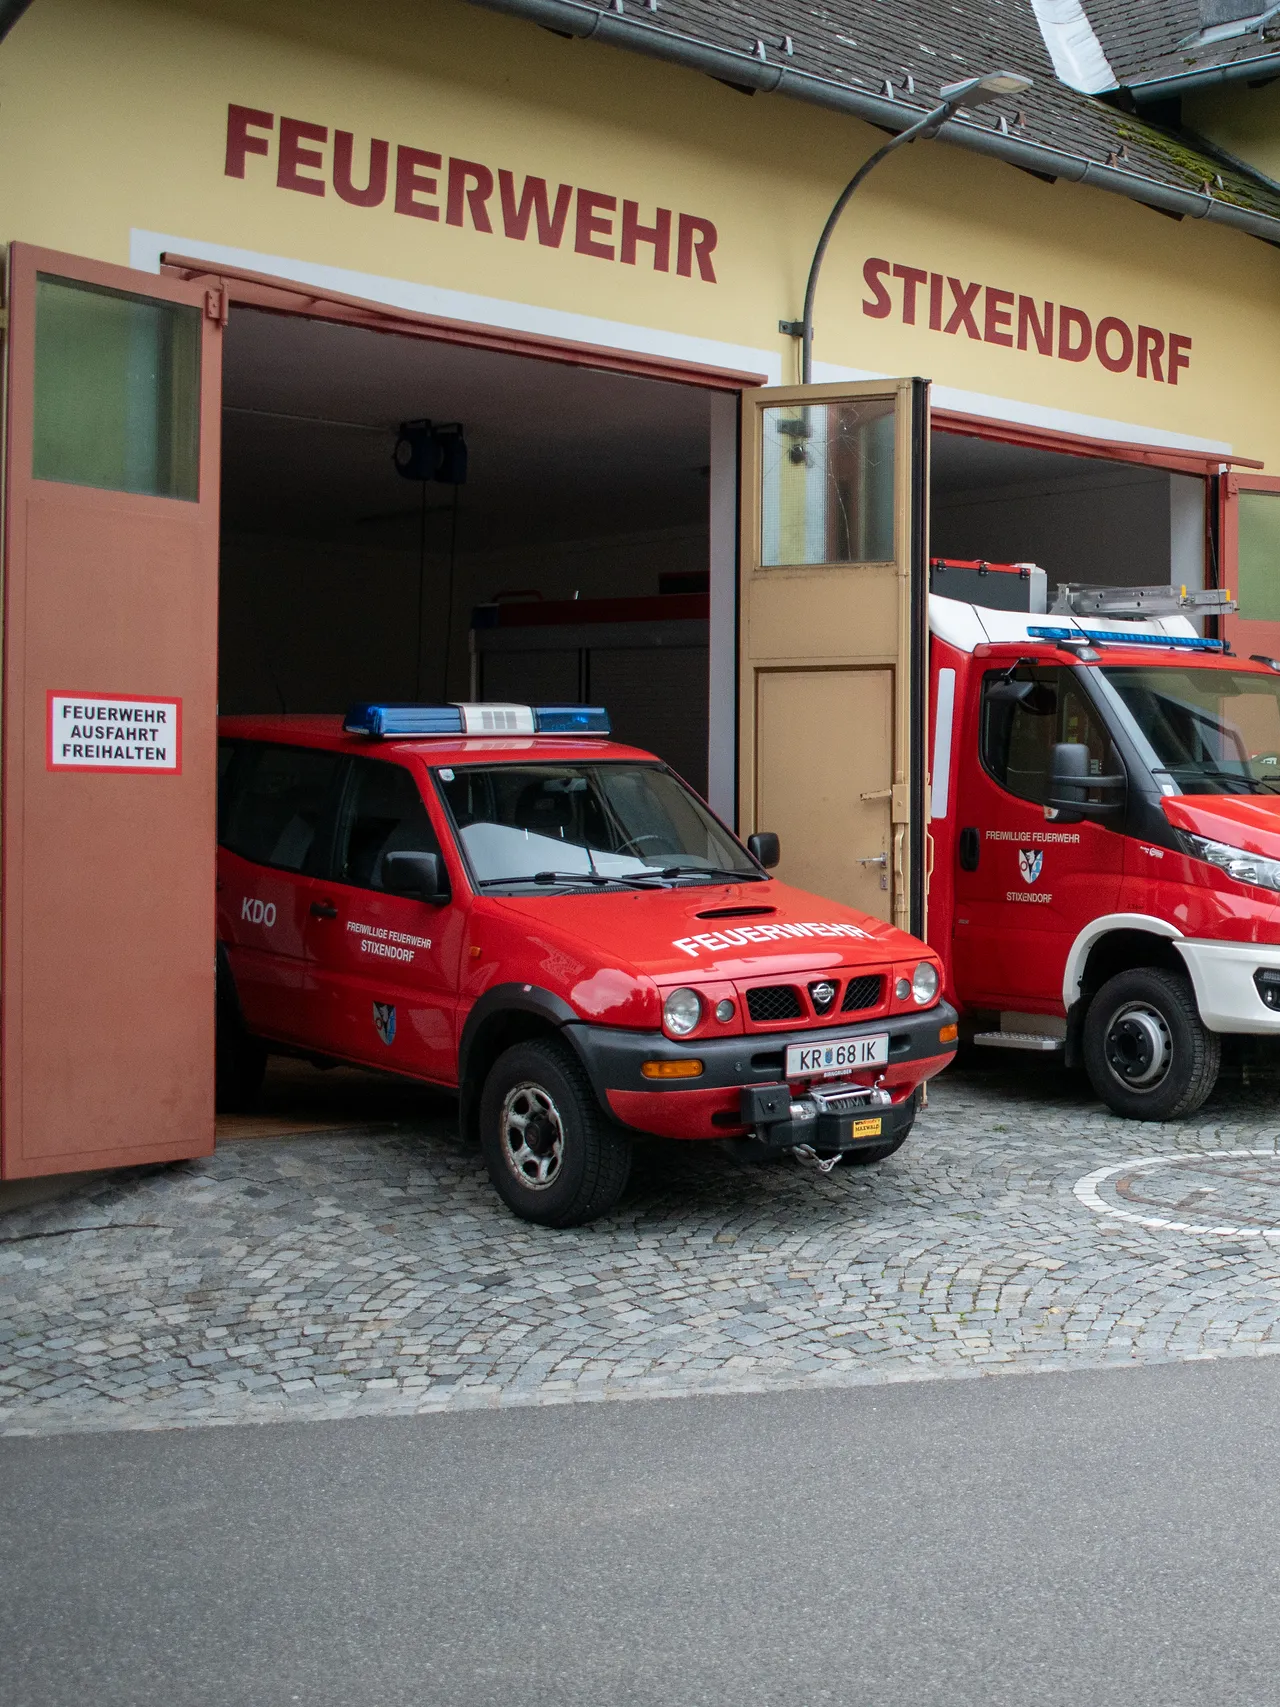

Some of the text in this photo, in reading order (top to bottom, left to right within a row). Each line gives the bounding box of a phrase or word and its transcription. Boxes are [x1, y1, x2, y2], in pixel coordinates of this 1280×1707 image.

[224, 103, 717, 284] FEUERWEHR
[862, 257, 1193, 386] STIXENDORF
[62, 704, 167, 724] FEUERWEHR
[70, 724, 159, 742] AUSFAHRT
[62, 743, 166, 761] FREIHALTEN
[985, 831, 1080, 844] FREIWILLIGE FEUERWEHR
[1006, 891, 1053, 904] STIXENDORF
[241, 897, 277, 928] KDO
[346, 921, 432, 949] FREIWILLIGE FEUERWEHR
[671, 922, 876, 957] FEUERWEHR
[361, 940, 415, 962] STIXENDORF
[800, 1041, 876, 1071] KR 68 IK
